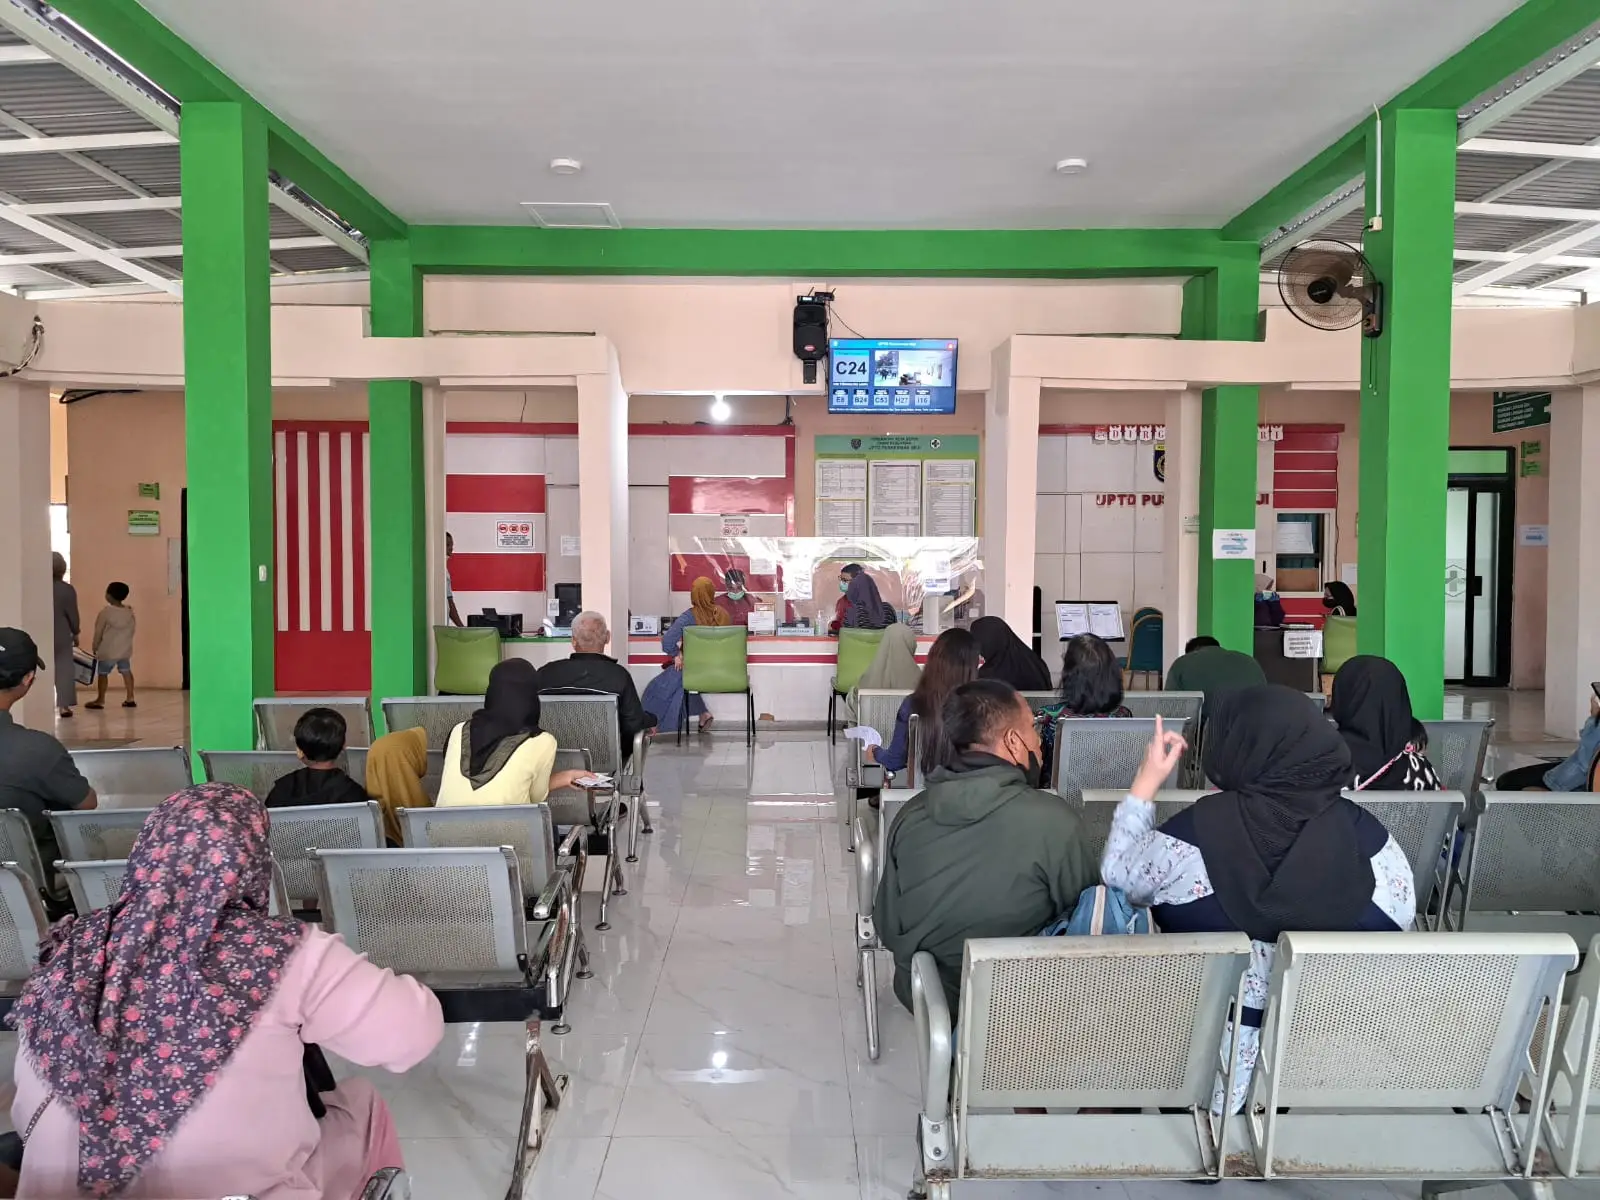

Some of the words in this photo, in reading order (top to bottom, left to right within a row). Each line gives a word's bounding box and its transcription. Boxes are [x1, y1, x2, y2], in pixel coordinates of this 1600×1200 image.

[836, 361, 867, 375] C24
[1096, 493, 1136, 506] UPTD
[1142, 494, 1165, 506] PU
